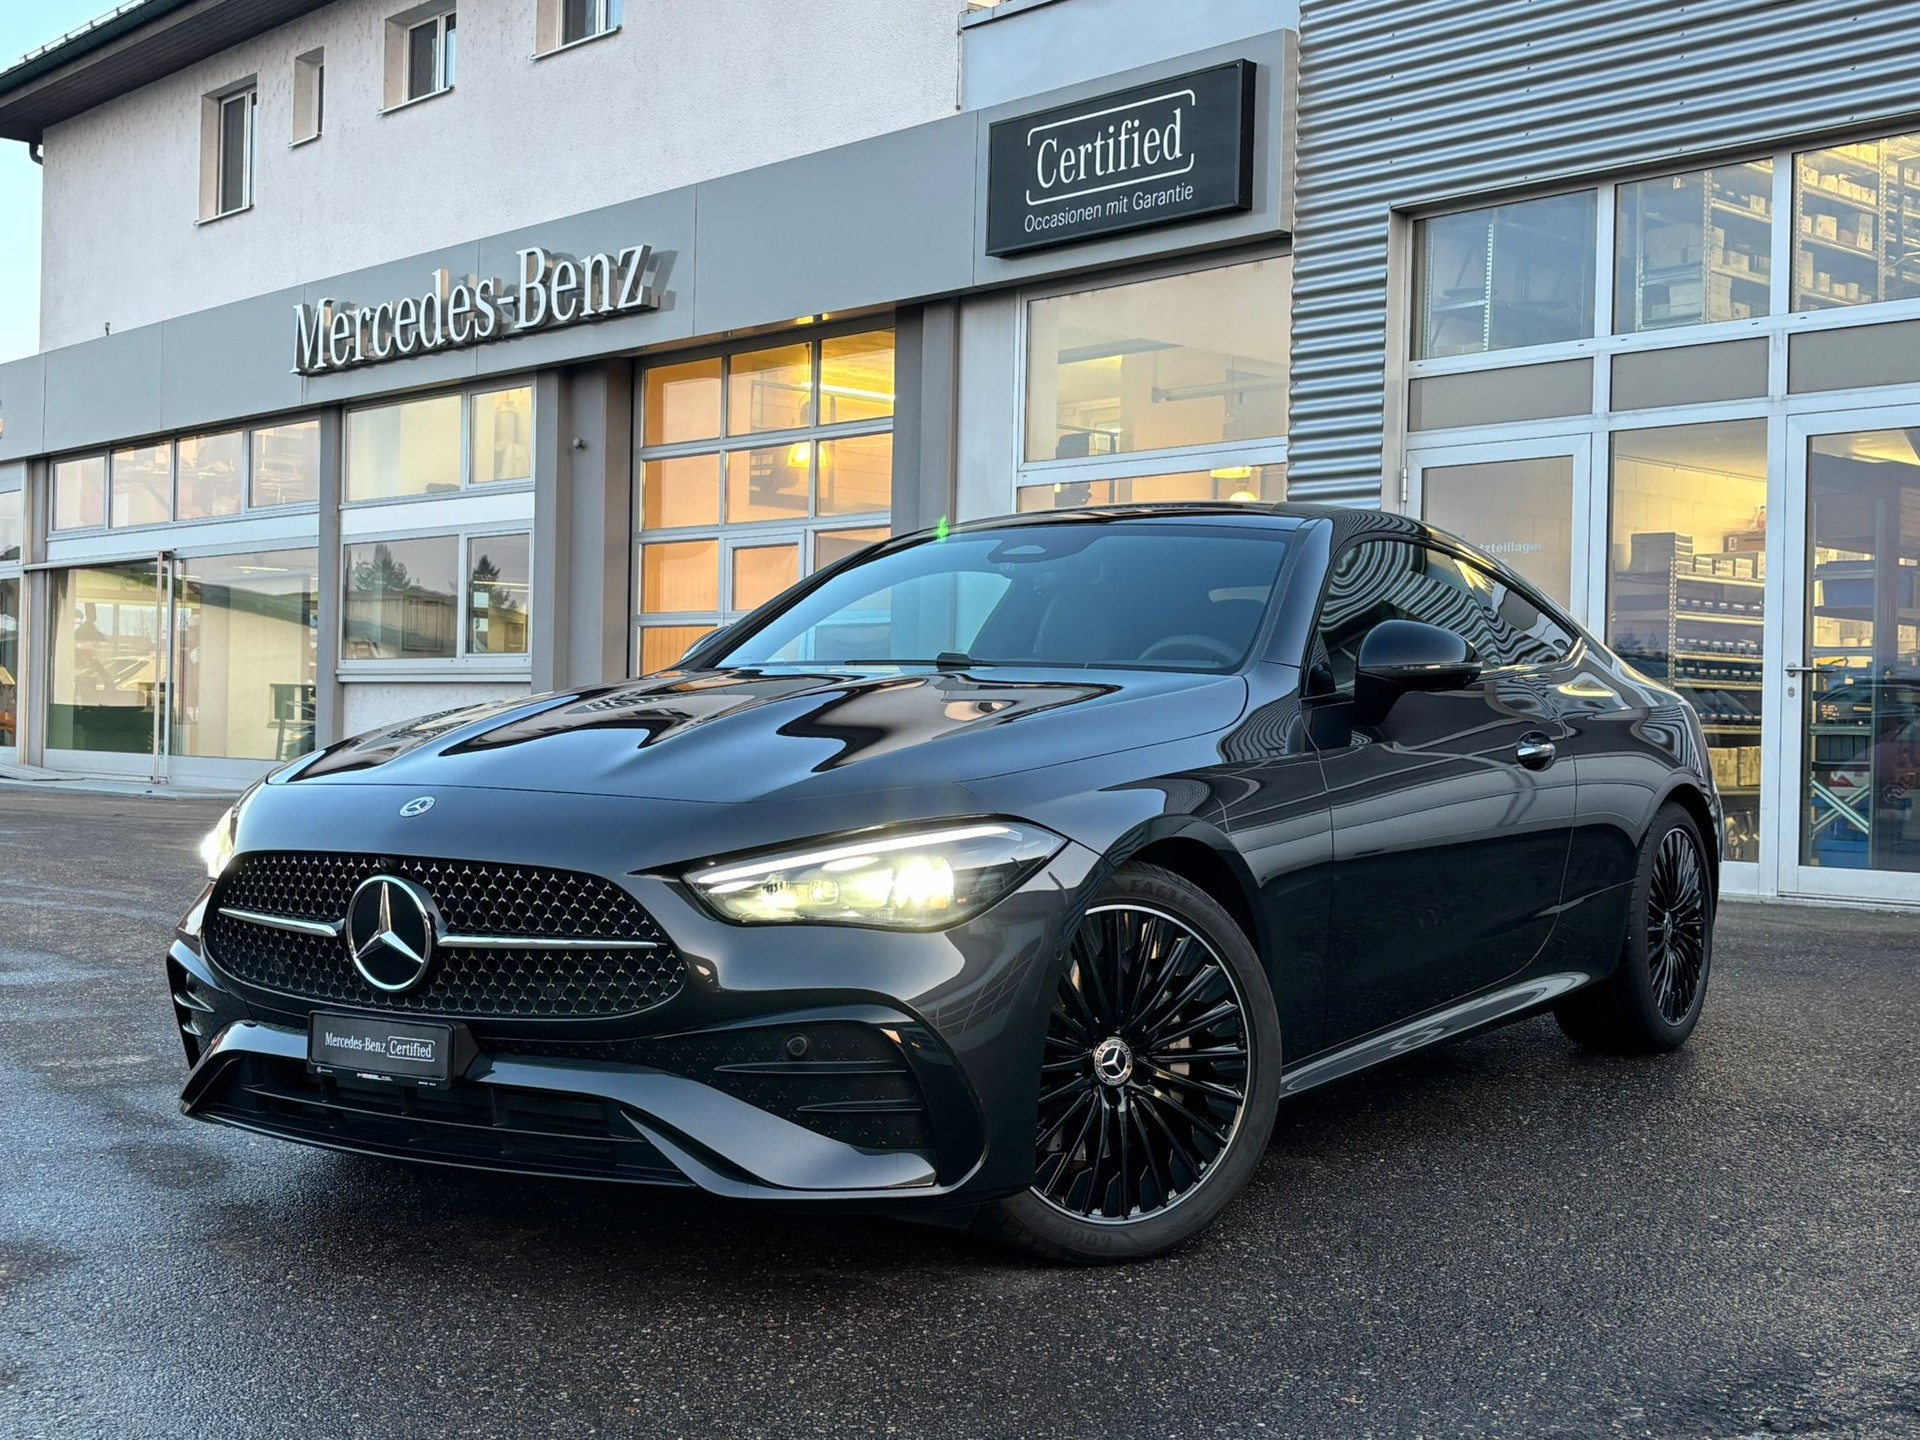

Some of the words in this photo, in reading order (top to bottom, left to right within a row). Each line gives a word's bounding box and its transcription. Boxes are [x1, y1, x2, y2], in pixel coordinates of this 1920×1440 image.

[1036, 107, 1183, 189] Certified
[1024, 204, 1102, 233] Occasionen
[1106, 195, 1129, 217] mit
[1132, 182, 1194, 211] Garantie
[289, 244, 653, 374] Mercedes-Benz
[324, 1031, 386, 1053] Mercedes-Benz
[389, 1040, 432, 1058] Certified
